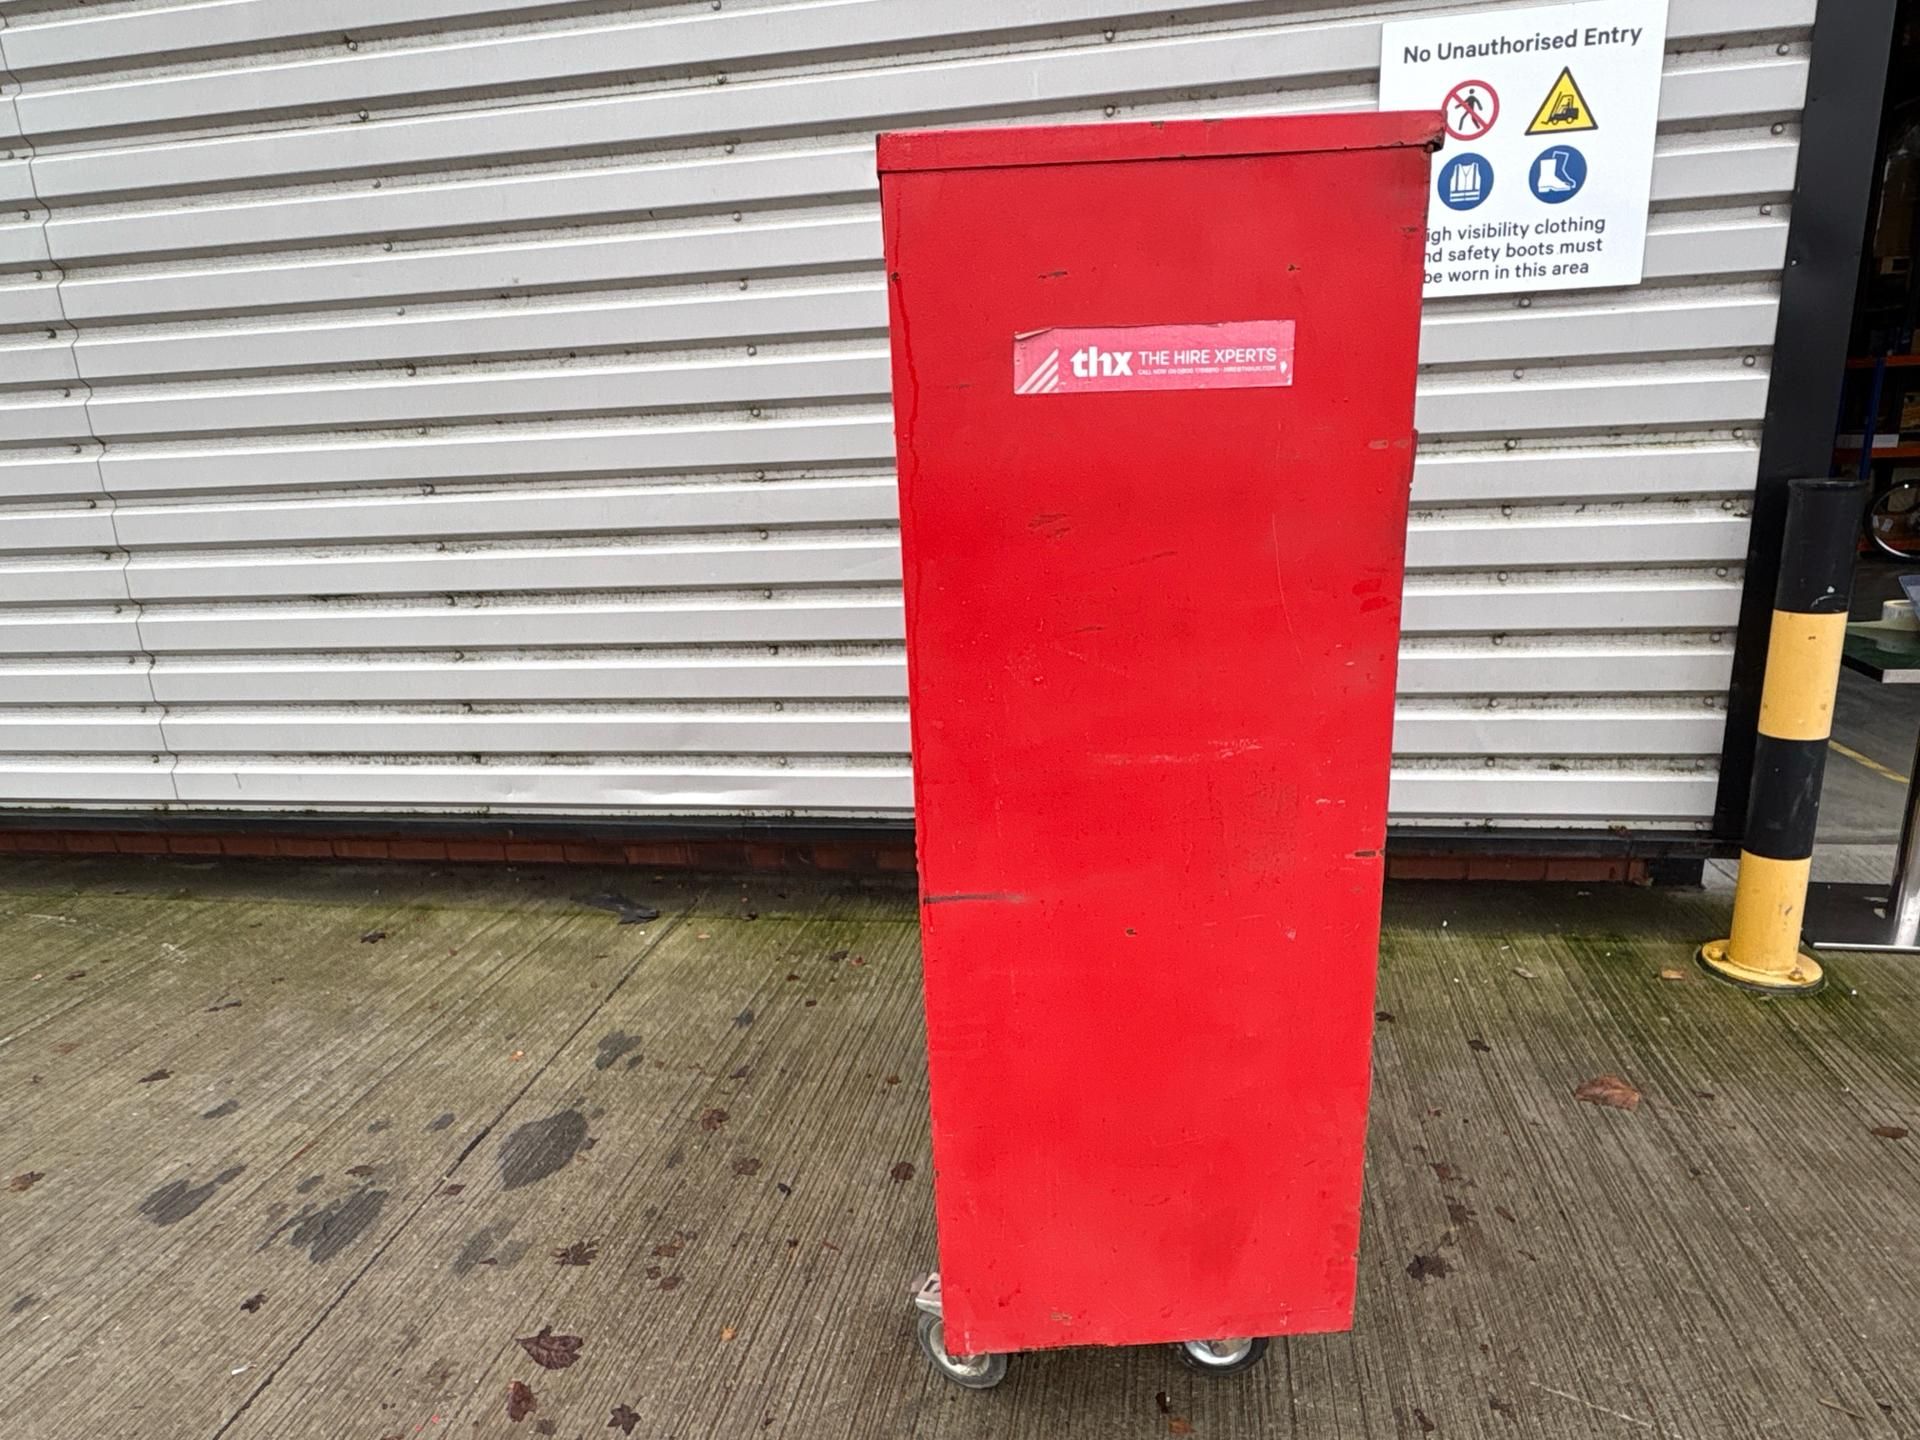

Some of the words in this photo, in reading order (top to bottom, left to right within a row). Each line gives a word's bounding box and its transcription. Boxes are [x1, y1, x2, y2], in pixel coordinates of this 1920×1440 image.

[1403, 45, 1431, 64] No
[1437, 29, 1578, 60] Unauthorised
[1584, 27, 1643, 46] Entry
[1426, 226, 1452, 246] igh
[1457, 221, 1530, 240] visibility
[1534, 216, 1606, 234] clothing
[1424, 247, 1443, 263] nd
[1448, 246, 1501, 262] safety
[1505, 243, 1554, 258] boots
[1559, 238, 1603, 254] must
[1447, 269, 1489, 283] worn
[1494, 264, 1510, 280] in
[1515, 262, 1547, 278] this
[1551, 261, 1589, 275] area
[1069, 346, 1134, 378] thx
[1138, 350, 1171, 366] THE
[1173, 349, 1210, 365] HIRE
[1214, 347, 1277, 364] XPERTS
